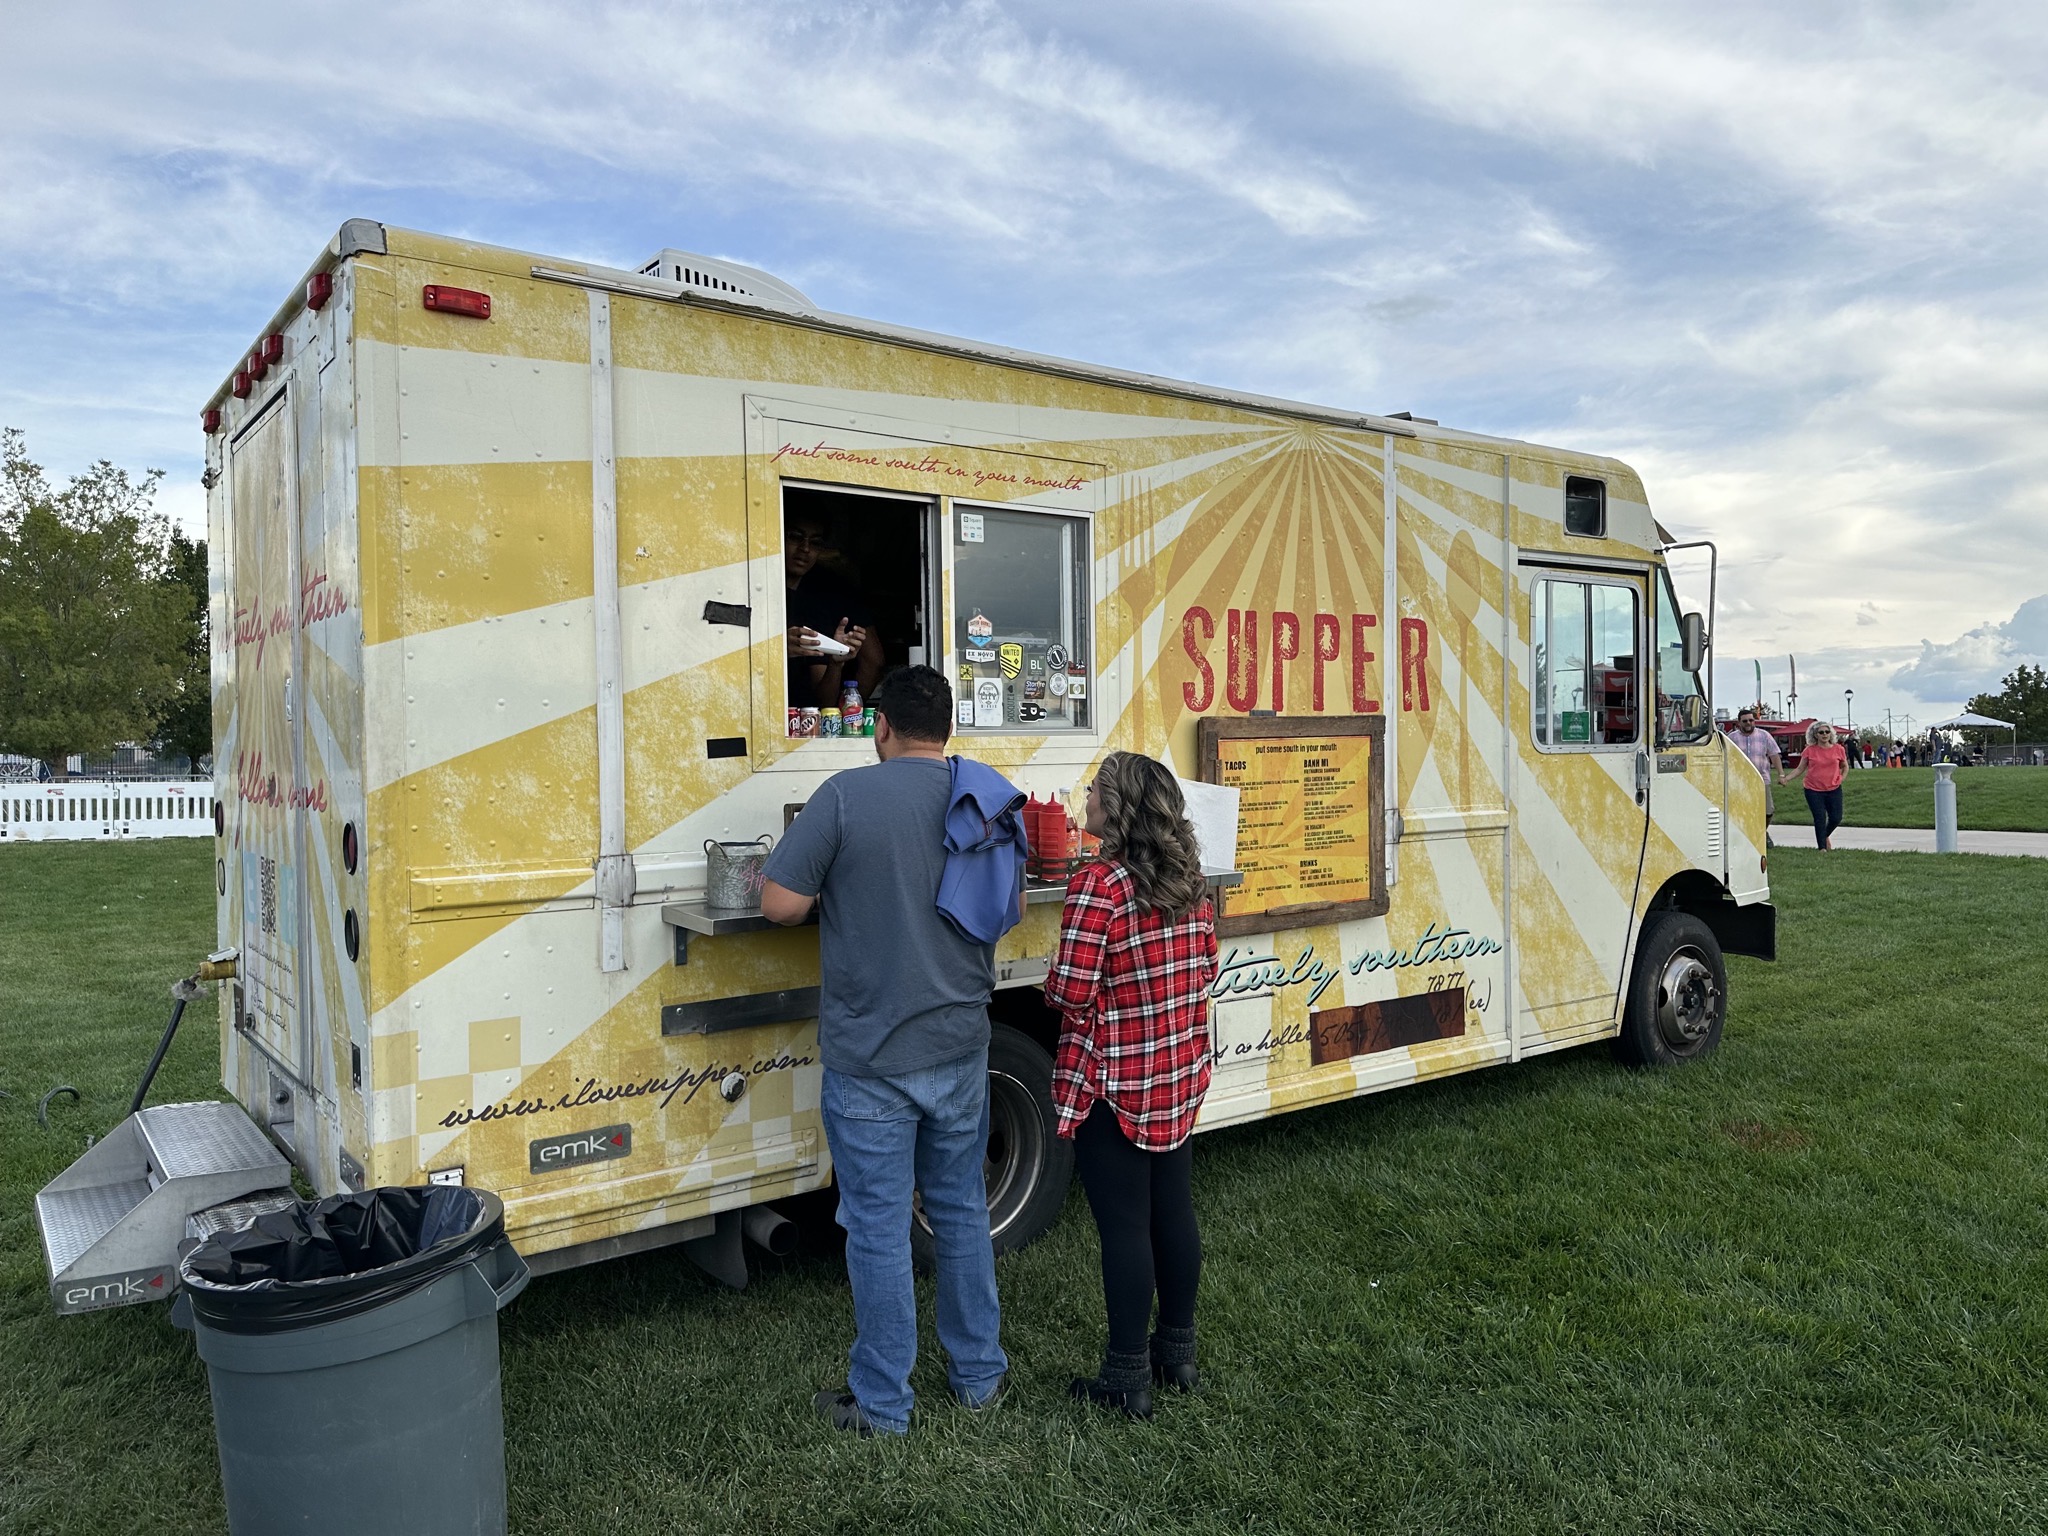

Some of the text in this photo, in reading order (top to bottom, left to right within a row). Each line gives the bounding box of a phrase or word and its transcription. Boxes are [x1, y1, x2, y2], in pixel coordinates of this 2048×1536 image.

[770, 441, 1091, 491] put some south in your mouth
[1030, 659, 1043, 670] BL
[1182, 606, 1430, 713] SUPPER
[1255, 745, 1266, 755] put
[1283, 744, 1299, 752] south
[1300, 744, 1306, 752] in
[1306, 744, 1319, 753] your
[1320, 743, 1338, 751] mouth
[1225, 760, 1246, 770] TACOS
[1303, 758, 1329, 768] BANH MI
[1660, 759, 1680, 768] emk
[1348, 922, 1502, 975] southern
[1235, 1043, 1252, 1055] a
[540, 1135, 607, 1163] emk
[65, 1276, 145, 1305] emk
